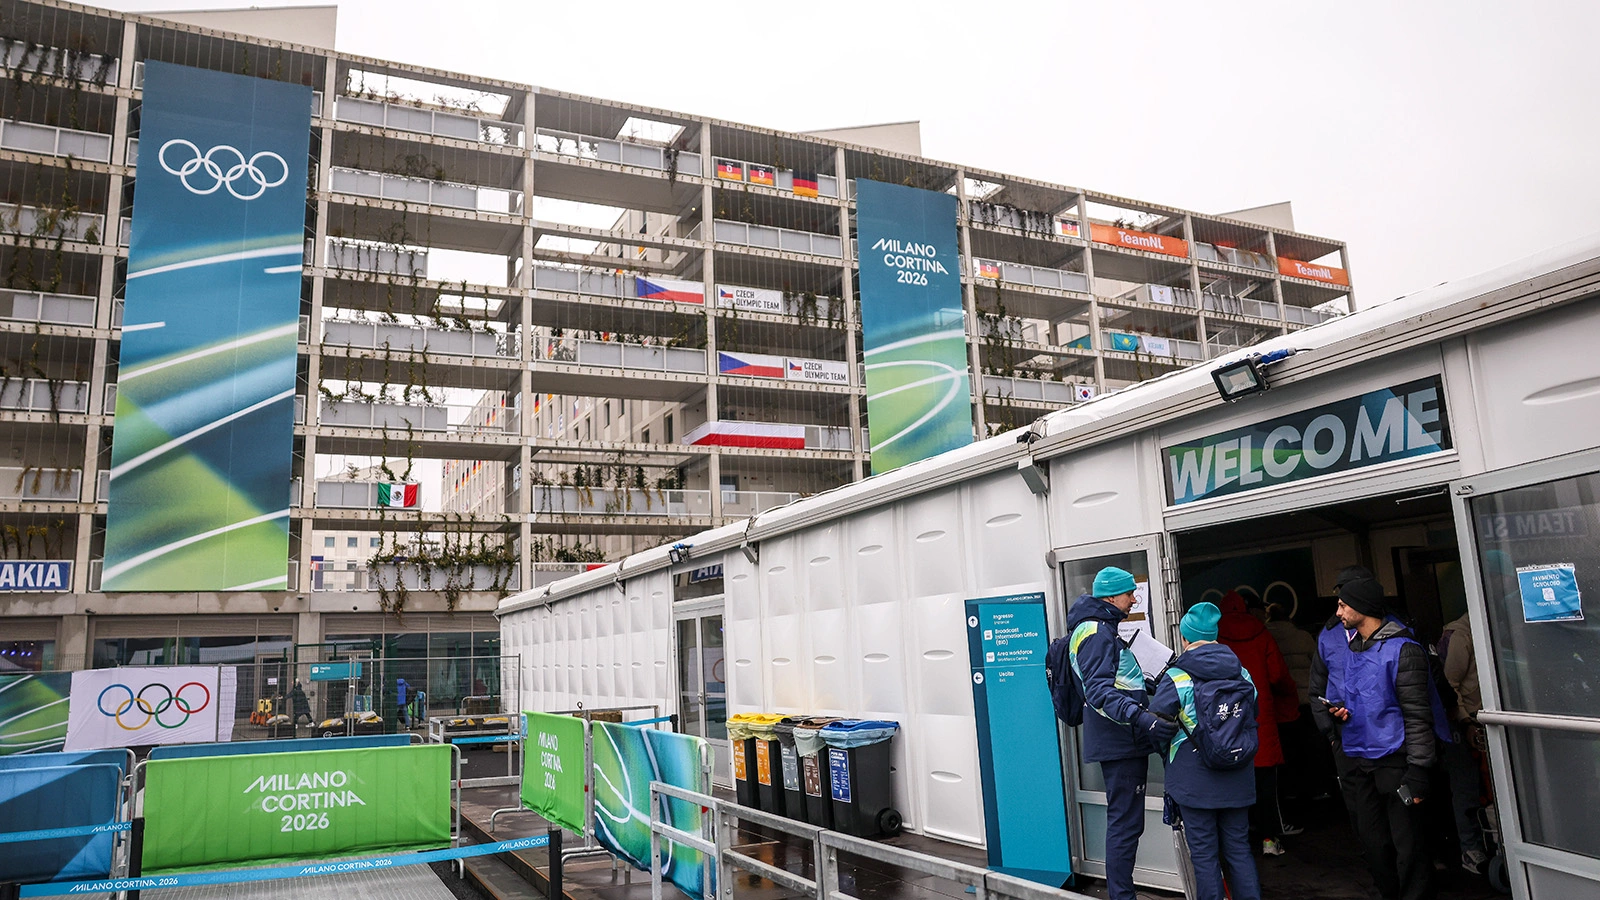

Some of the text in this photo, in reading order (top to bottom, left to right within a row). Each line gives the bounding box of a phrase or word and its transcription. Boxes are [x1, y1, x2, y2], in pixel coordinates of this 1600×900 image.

[871, 238, 936, 258] MILANO
[1118, 231, 1164, 250] TeamNL
[883, 253, 949, 275] CORTINA
[1295, 263, 1333, 279] TeamNL
[896, 270, 928, 286] 2026
[735, 289, 755, 299] CZECH
[735, 298, 779, 310] OLYMPIC TEAM
[804, 361, 823, 371] CZECH
[804, 371, 847, 381] OLYMPIC TEAM
[1169, 387, 1442, 500] WELCOME
[995, 627, 1019, 635] Broadcast
[537, 731, 559, 751] MILANO
[243, 770, 347, 794] MILANO
[262, 790, 366, 813] CORTINA
[91, 823, 122, 833] MILANO
[280, 812, 330, 832] 2026
[497, 839, 530, 851] MILANO
[299, 859, 392, 875] MILANO CORTINA 2026
[69, 877, 179, 893] MILANO CORTINA 2026
